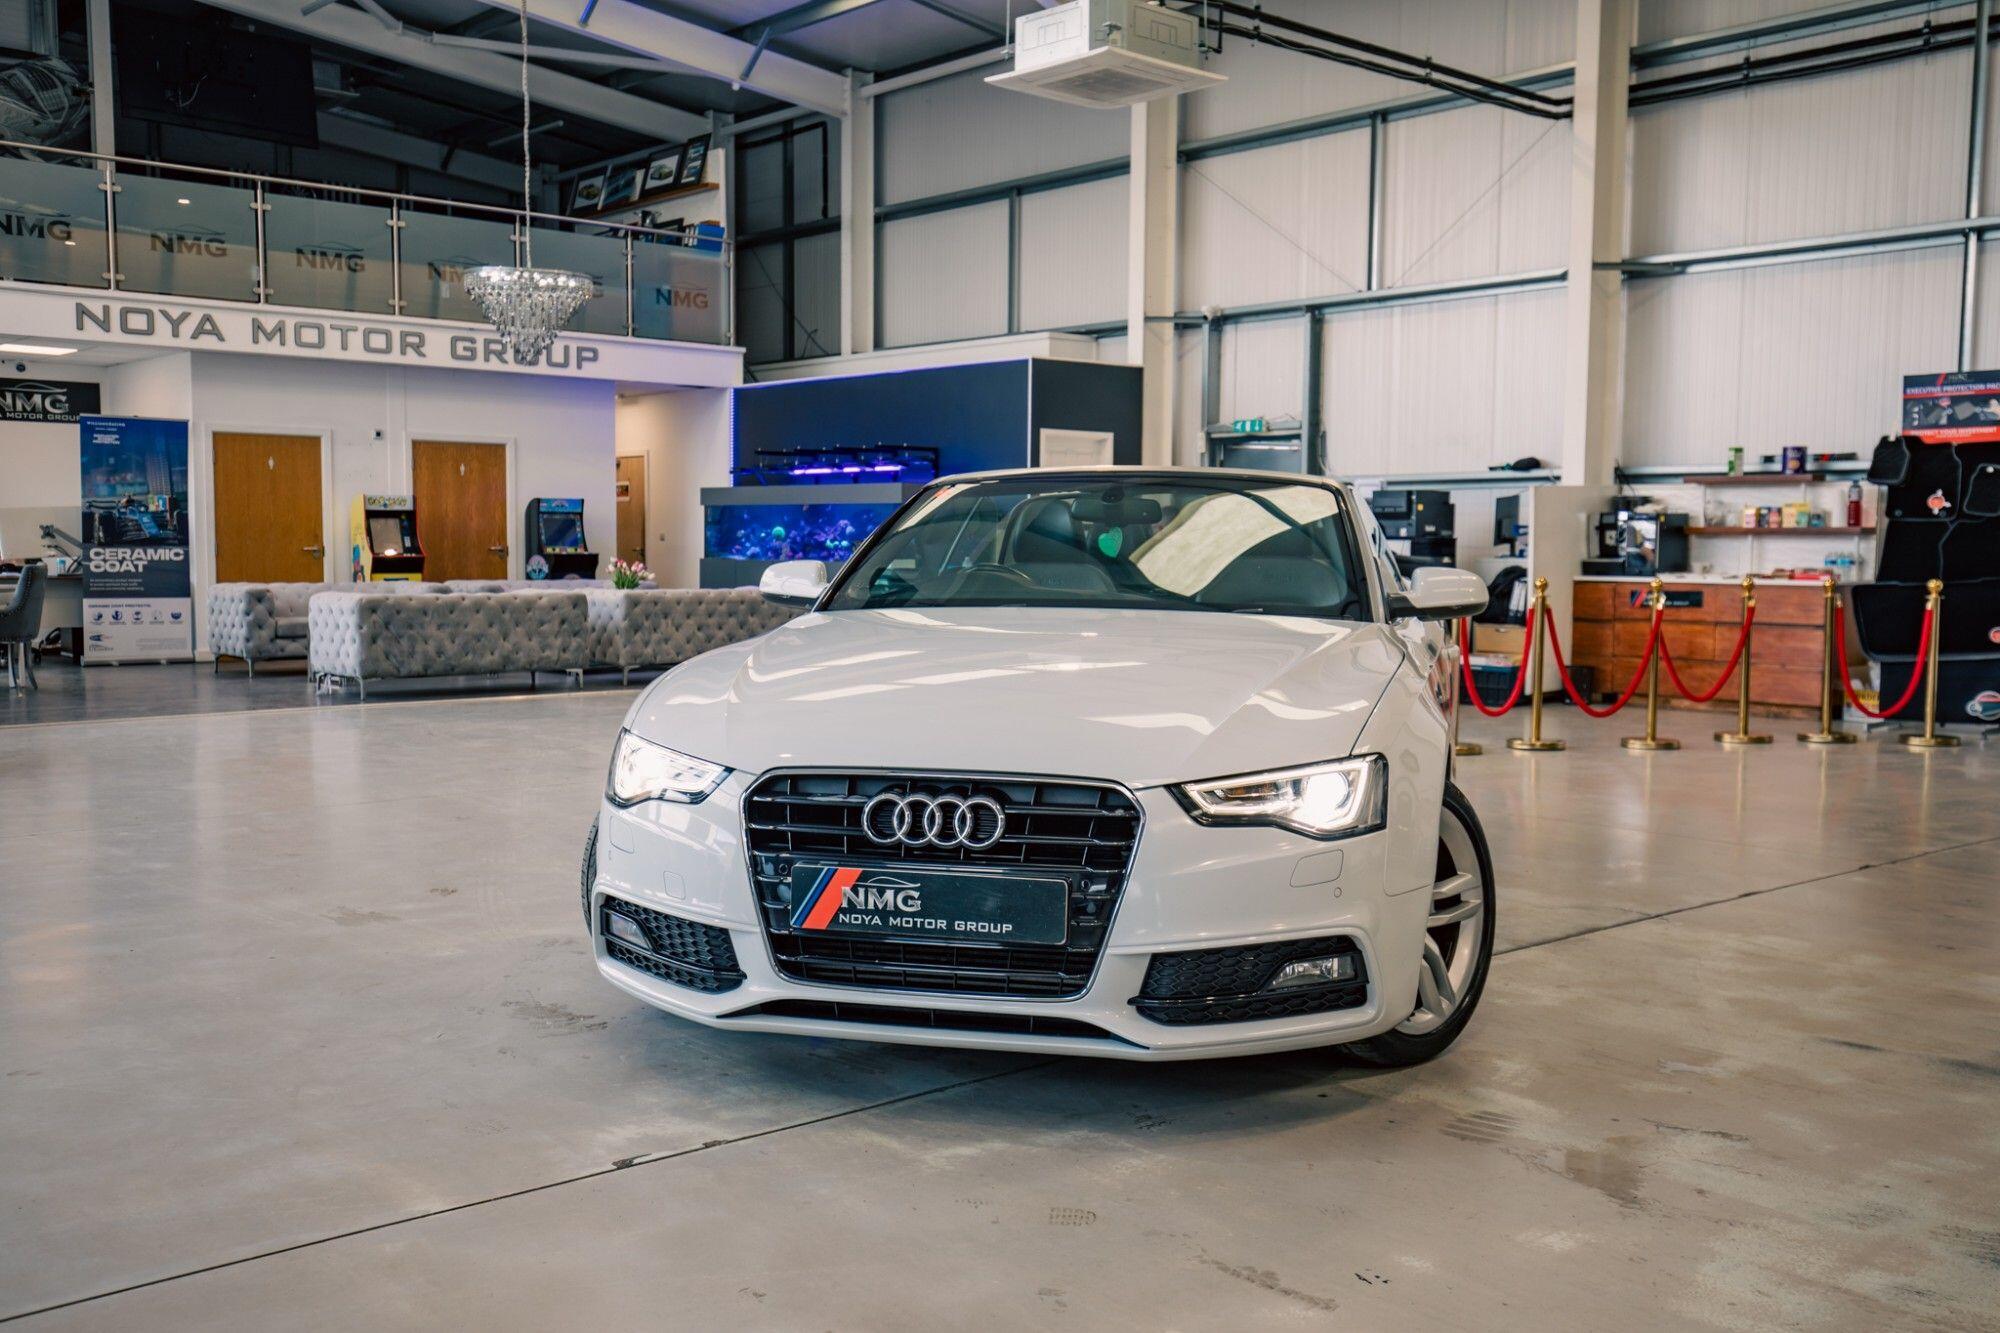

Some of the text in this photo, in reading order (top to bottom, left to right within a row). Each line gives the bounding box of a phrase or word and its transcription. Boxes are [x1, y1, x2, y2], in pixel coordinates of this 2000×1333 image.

[0, 214, 72, 241] NMG
[150, 234, 228, 257] NMG
[296, 248, 365, 273] NMG
[655, 287, 709, 309] NMG
[76, 302, 225, 342] NOYA
[252, 317, 426, 358] MOTOR
[6, 412, 43, 420] MOTOR
[89, 547, 185, 561] CERAMIC
[89, 560, 148, 573] COAT
[841, 886, 921, 912] NMG
[839, 913, 1013, 934] NOYA MOTOR GROUP
